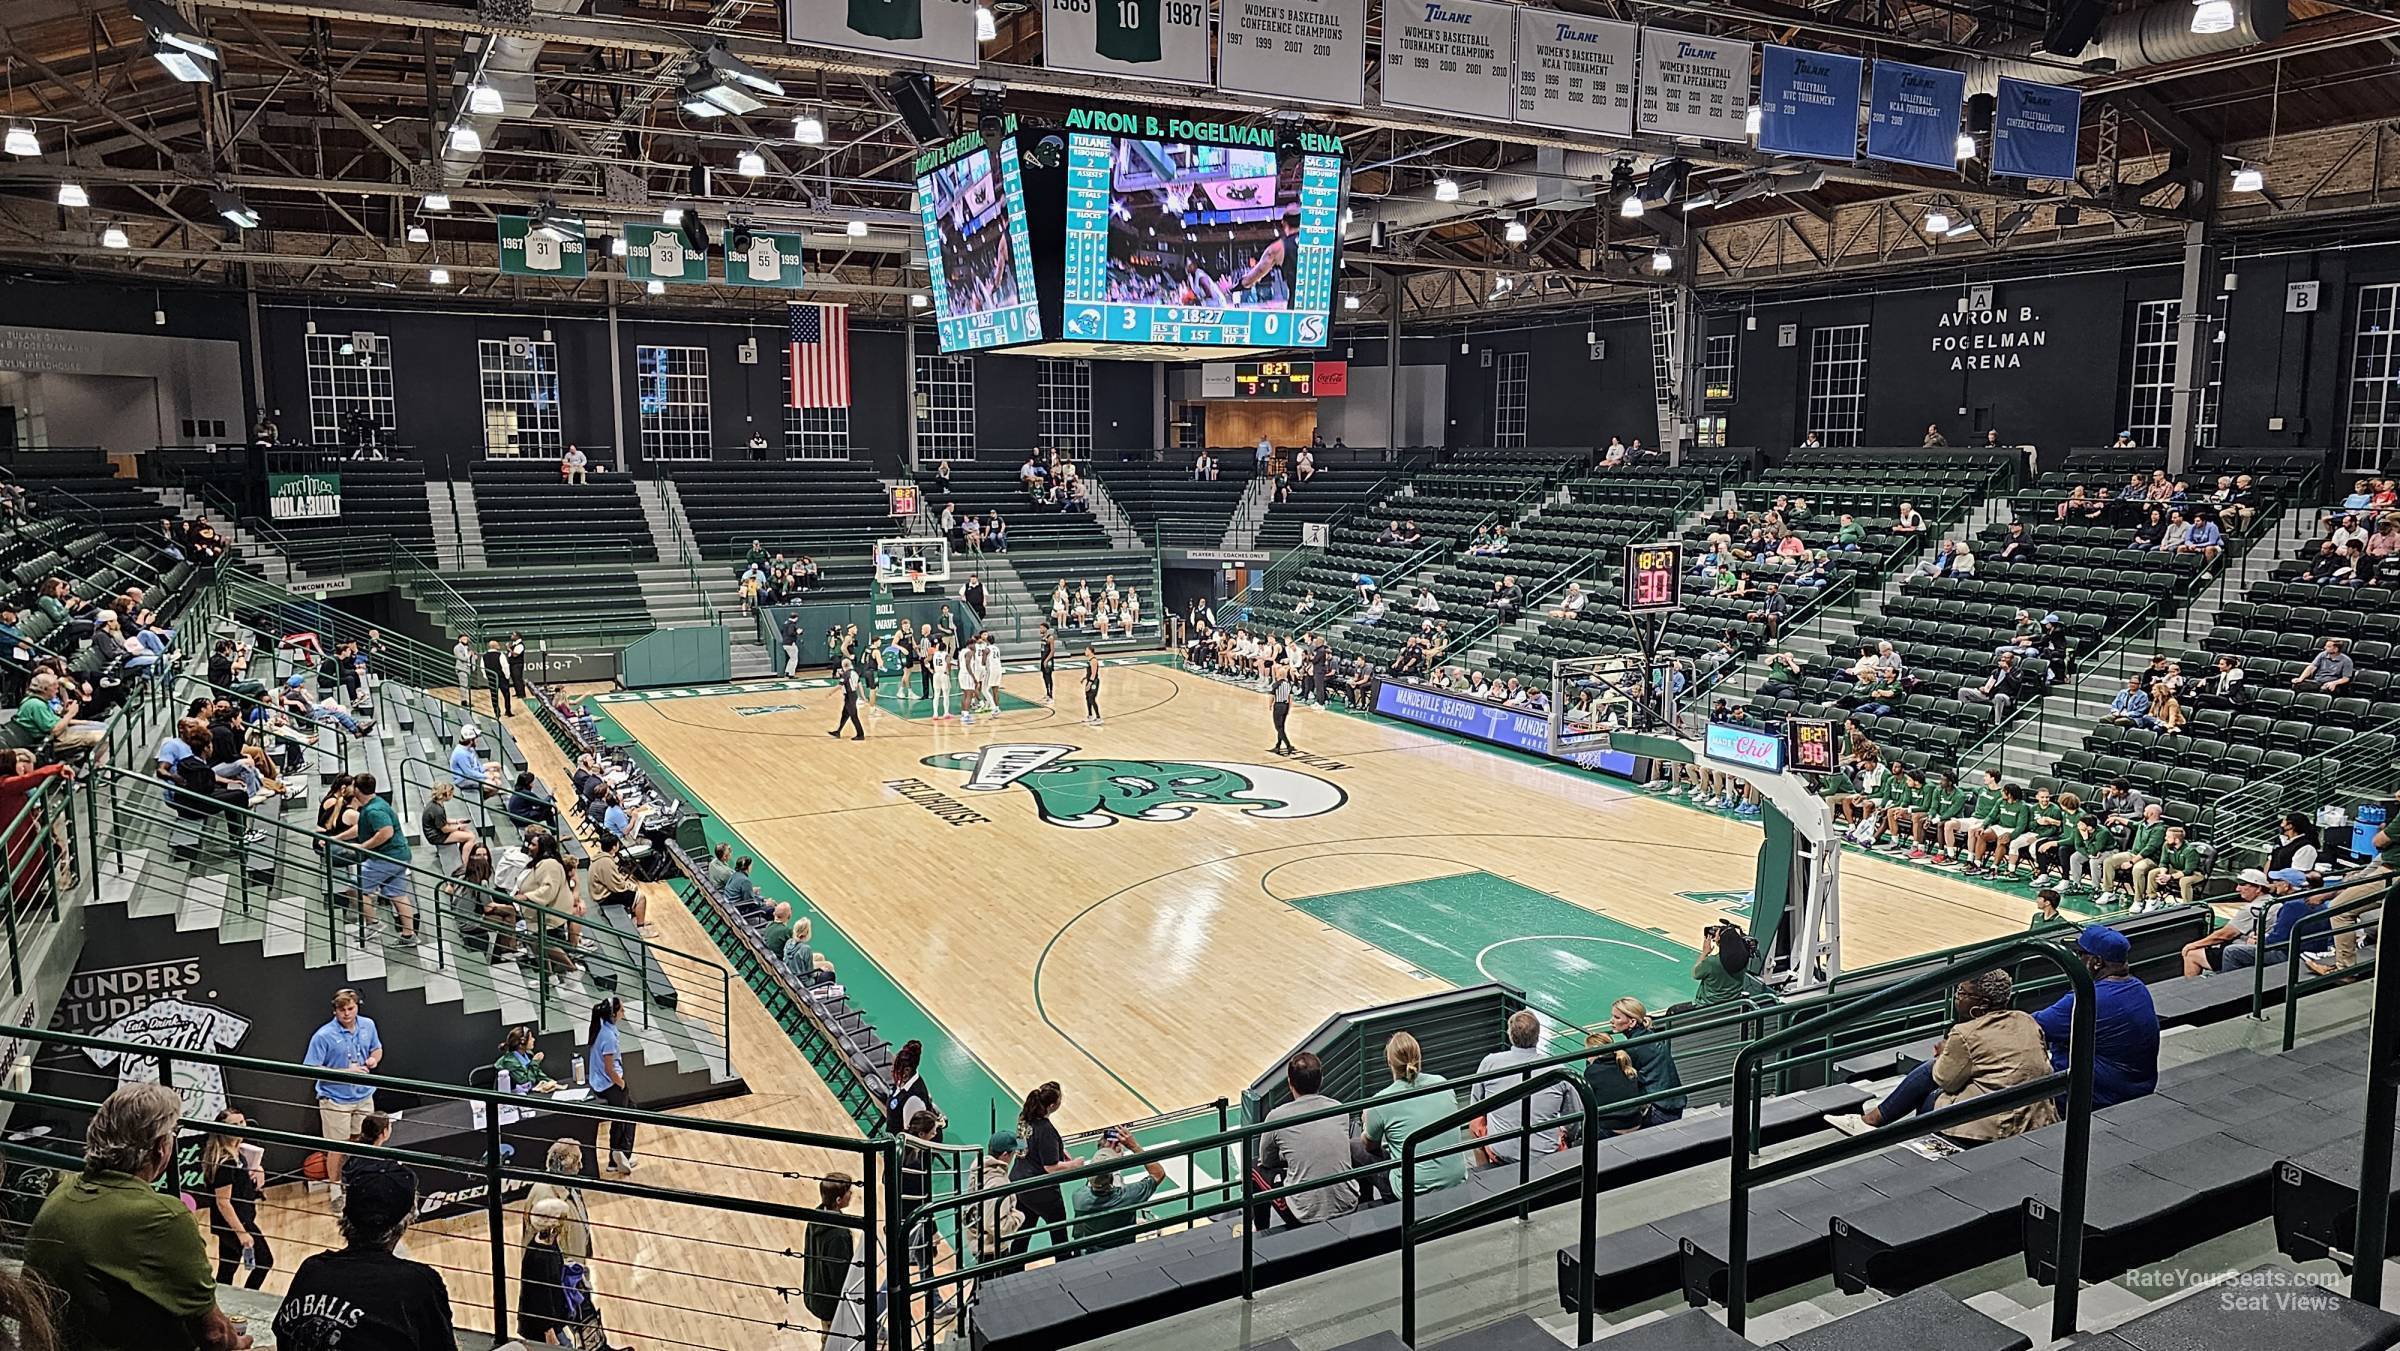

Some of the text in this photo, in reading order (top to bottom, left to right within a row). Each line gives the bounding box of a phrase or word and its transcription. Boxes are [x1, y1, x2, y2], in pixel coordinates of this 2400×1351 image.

[1117, 0, 1138, 29] 10
[1166, 2, 1202, 27] 1987
[1244, 3, 1340, 28] WOMEN'S BASKETBALL
[1424, 2, 1472, 24] TULANE
[1240, 16, 1343, 41] CONFERENCE CHAMPIONS
[1556, 23, 1599, 44] TULANE
[1226, 31, 1331, 57] 1997 1999 2007 2010
[1404, 26, 1490, 48] WOMEN'S BASKETBALL
[1400, 38, 1495, 60] TOURNAMENT CHAMPIONS
[1536, 44, 1615, 65] WOMEN'S BASKETBALL
[1677, 41, 1718, 60] TULANE
[1388, 53, 1508, 78] 1997 1999 2000 2001 2010
[1542, 58, 1608, 76] NCAA TOURNAMENT
[1659, 60, 1732, 80] WOMEN'S BASKETBALL
[1520, 70, 1536, 82] 1995
[1568, 78, 1583, 89] 1997
[1662, 72, 1728, 91] WNIT APPEARANCES
[1792, 80, 1828, 94] VOLLEYBALL
[1798, 92, 1836, 106] TOURNAMENT
[1066, 108, 1137, 134] AVRON
[1146, 116, 1164, 138] B.
[1169, 119, 1274, 148] FOGELMAN
[946, 130, 984, 161] FOGELMA
[1073, 136, 1110, 148] TULANE
[1088, 158, 1094, 168] 2
[502, 238, 524, 250] 1967
[536, 242, 548, 255] 31
[562, 242, 582, 254] 1969
[629, 246, 649, 258] 1980
[660, 250, 673, 262] 33
[758, 256, 770, 266] 55
[781, 254, 800, 266] 1993
[1974, 294, 1986, 308] A
[2296, 292, 2308, 308] B
[956, 320, 964, 340] 3
[1010, 310, 1018, 327] 0
[1122, 309, 1279, 335] 3 18:27 0
[1938, 306, 2040, 328] AVRON B.
[1190, 330, 1211, 341] 1ST
[1784, 332, 1792, 344] T
[1932, 330, 2046, 352] FOGELMAN
[360, 338, 370, 350] N
[514, 343, 526, 354] O
[1594, 346, 1600, 358] S
[744, 352, 752, 362] P
[1950, 354, 2020, 370] ARENA
[1262, 362, 1290, 376] 18:27
[1248, 382, 1309, 394] 3 0
[270, 494, 341, 517] NOLA BUILT
[896, 498, 912, 513] 30
[1638, 550, 1673, 570] 18:27
[293, 581, 345, 592] NEWCOMB PLACE
[1638, 570, 1668, 602] 30
[876, 604, 894, 615] ROLL
[875, 619, 898, 630] WAVE
[524, 660, 572, 672] IONS Q-T
[936, 658, 943, 667] 12
[1395, 690, 1476, 720] MANDEVILLE SEAFOOD
[1520, 737, 1548, 750] MARKE
[882, 778, 992, 827] FIELDHOUSE
[63, 963, 200, 1000] UNDERS
[2282, 1168, 2299, 1183] 12
[2032, 1203, 2044, 1216] 11
[1834, 1222, 1848, 1235] 10
[1684, 1241, 1693, 1254] 9
[1562, 1253, 1570, 1264] 8
[280, 1293, 366, 1330] NO BALLS
